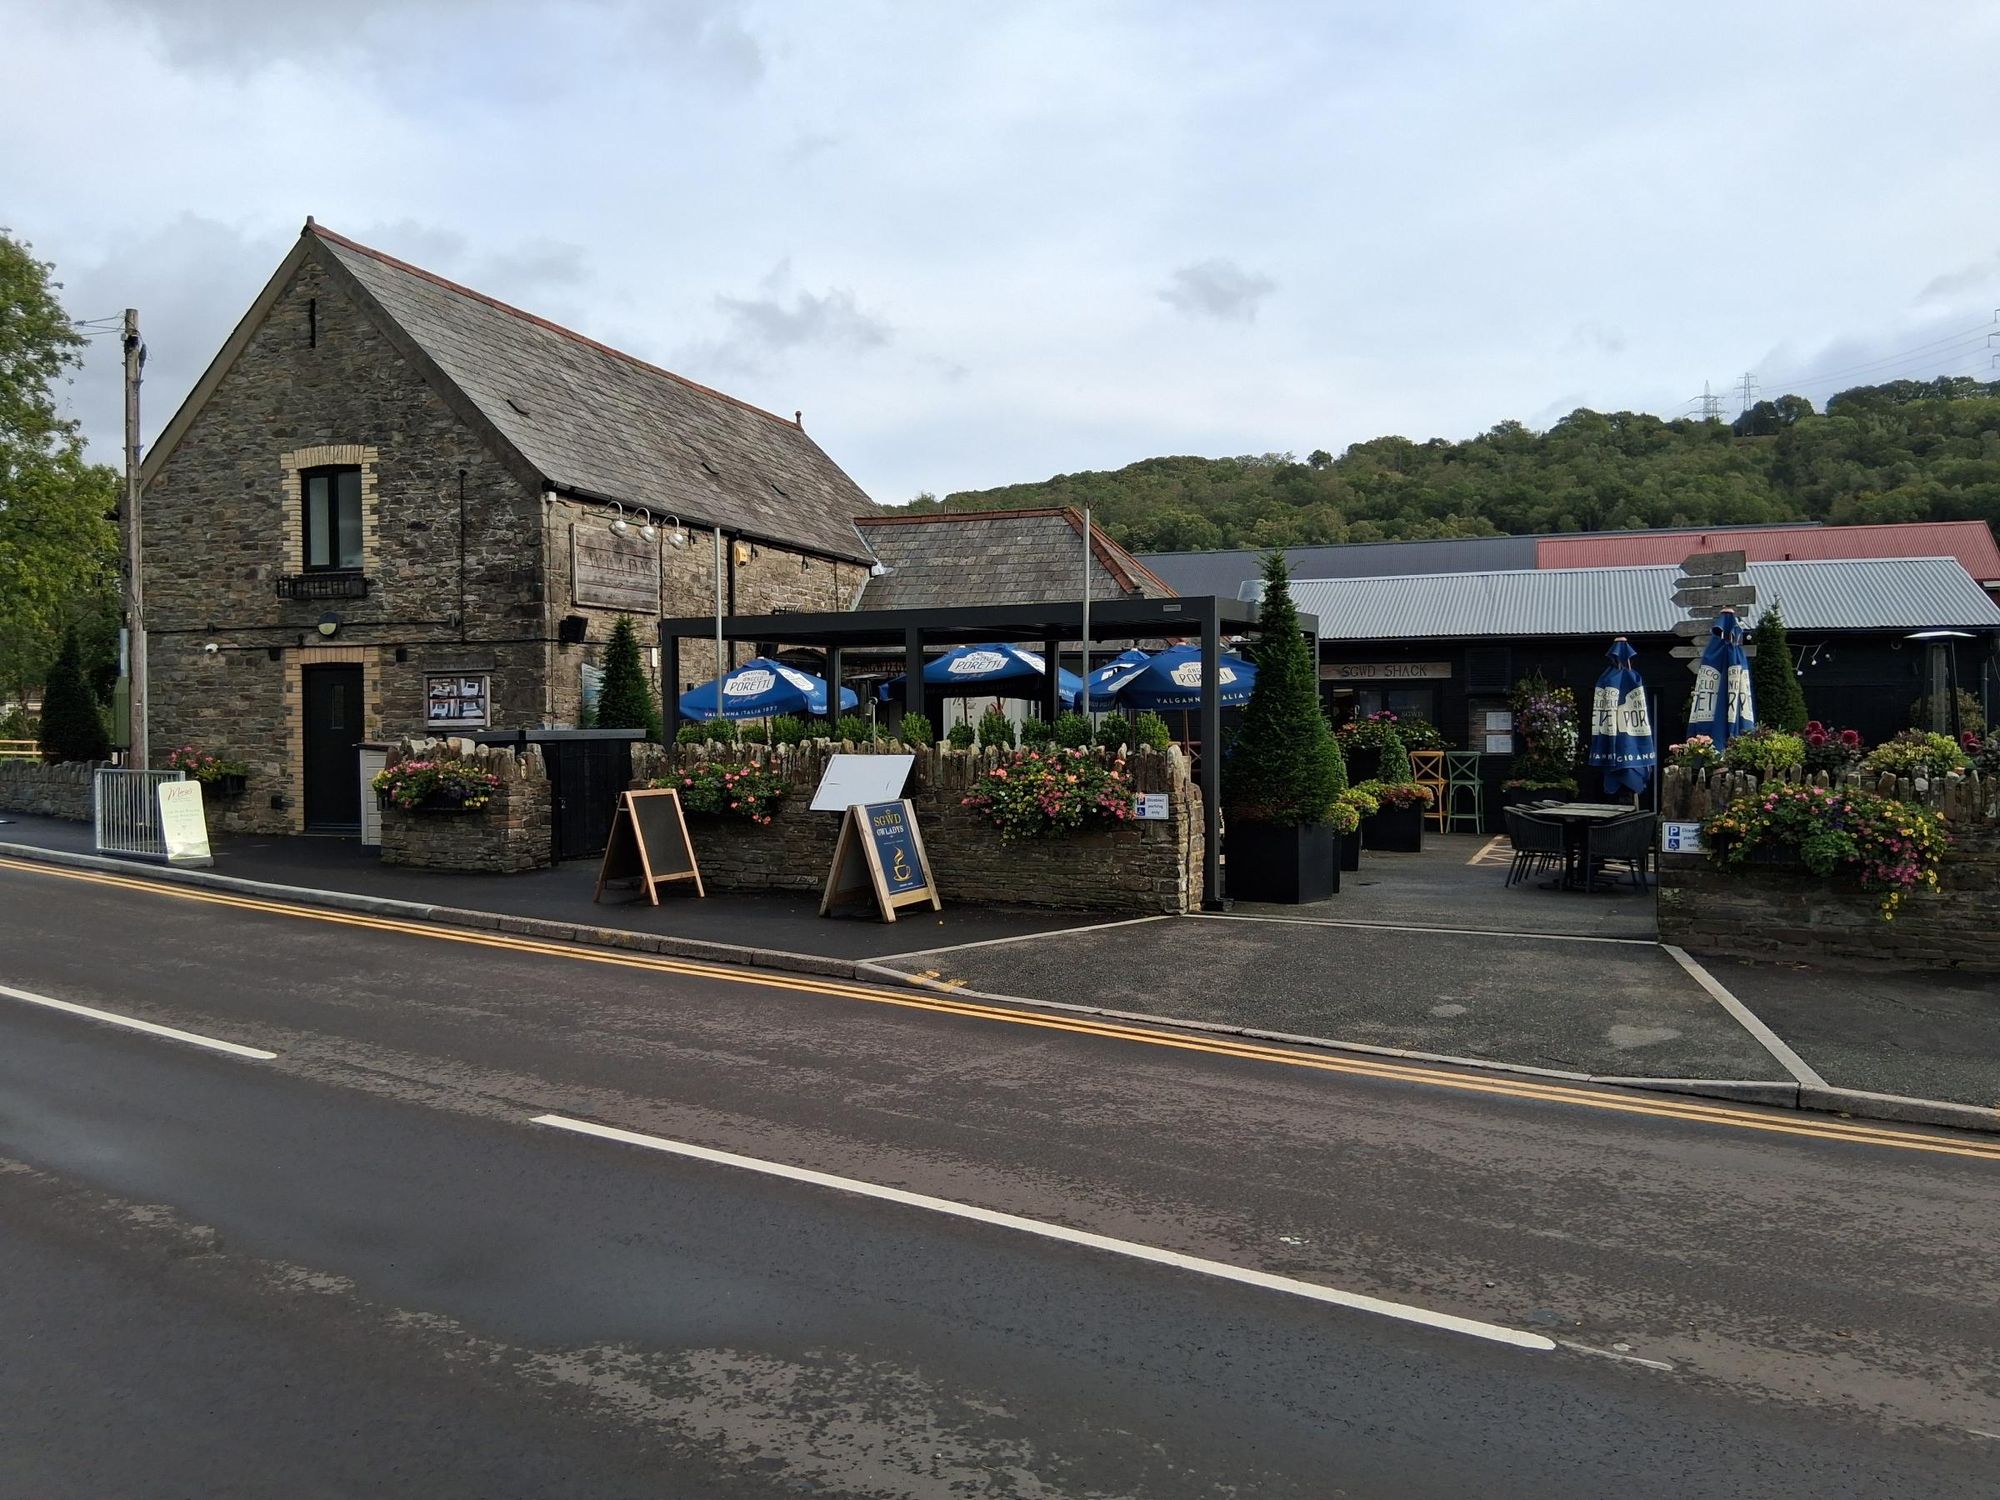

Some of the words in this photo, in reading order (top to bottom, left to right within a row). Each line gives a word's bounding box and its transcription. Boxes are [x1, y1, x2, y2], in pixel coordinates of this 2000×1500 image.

[955, 659, 1001, 671] PORETTI
[1341, 665, 1376, 678] SGWD
[1384, 664, 1428, 677] SHACK
[730, 679, 771, 692] PORETTI
[874, 813, 901, 827] SGWD
[877, 825, 904, 836] GWLADYS
